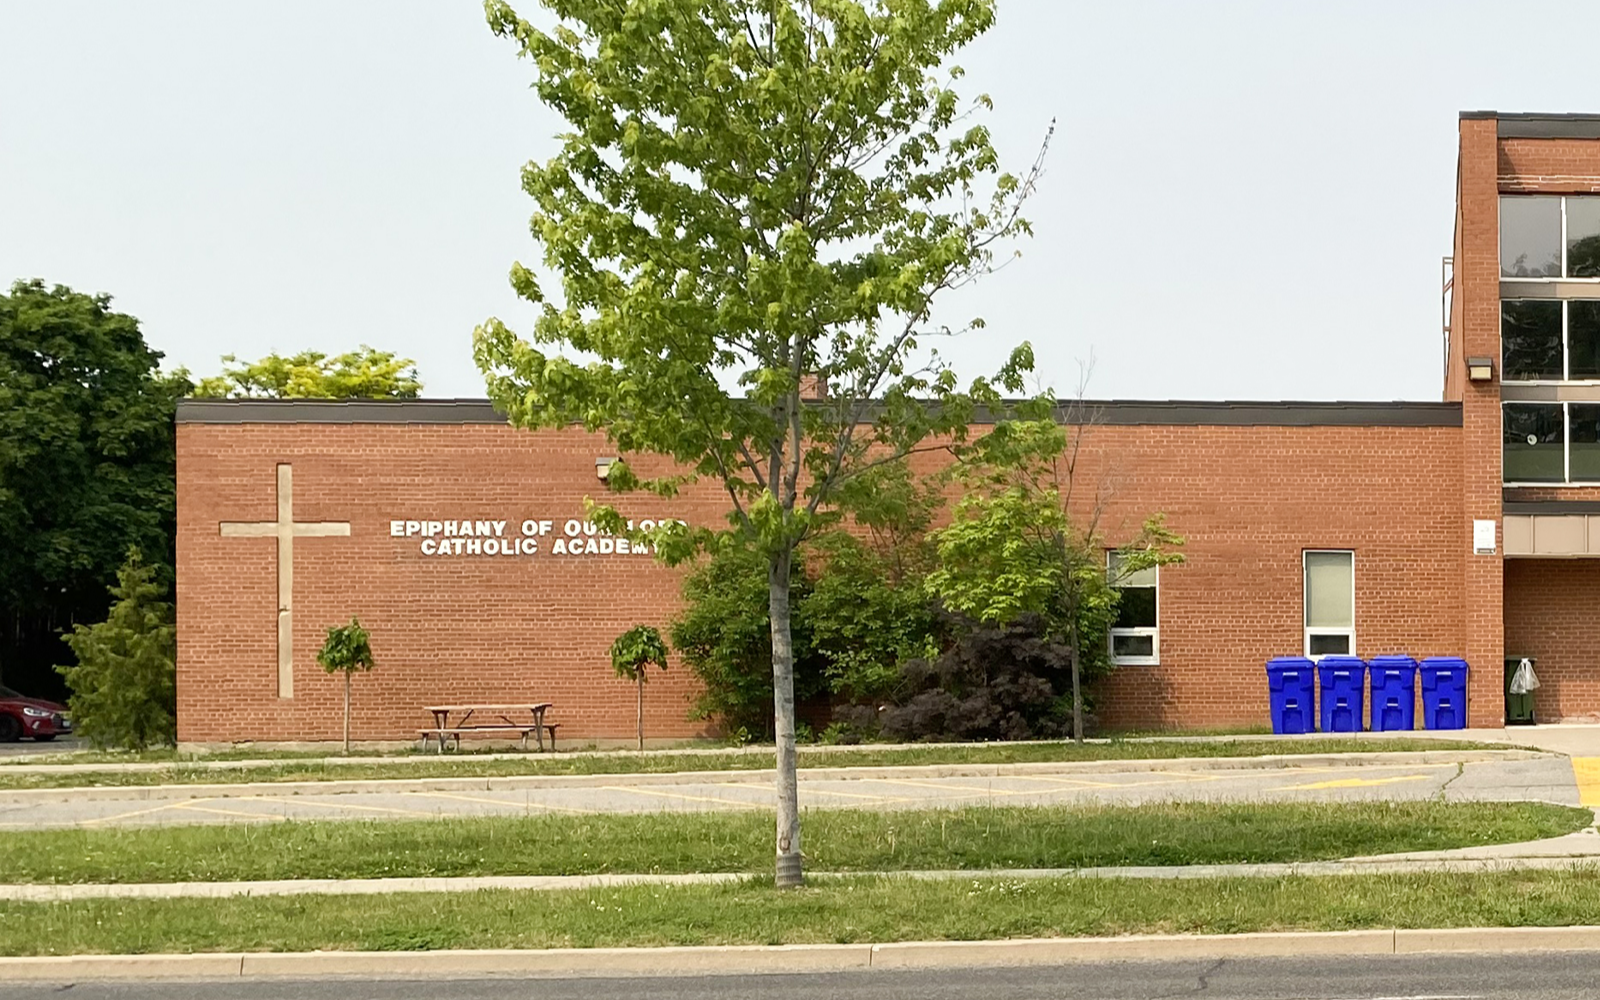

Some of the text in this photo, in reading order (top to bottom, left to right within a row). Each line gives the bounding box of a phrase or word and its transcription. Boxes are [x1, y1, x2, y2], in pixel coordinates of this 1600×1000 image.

[390, 520, 506, 537] EPIPHANY
[521, 520, 553, 537] OF
[564, 519, 613, 537] OU
[420, 538, 538, 556] CATHOLIC
